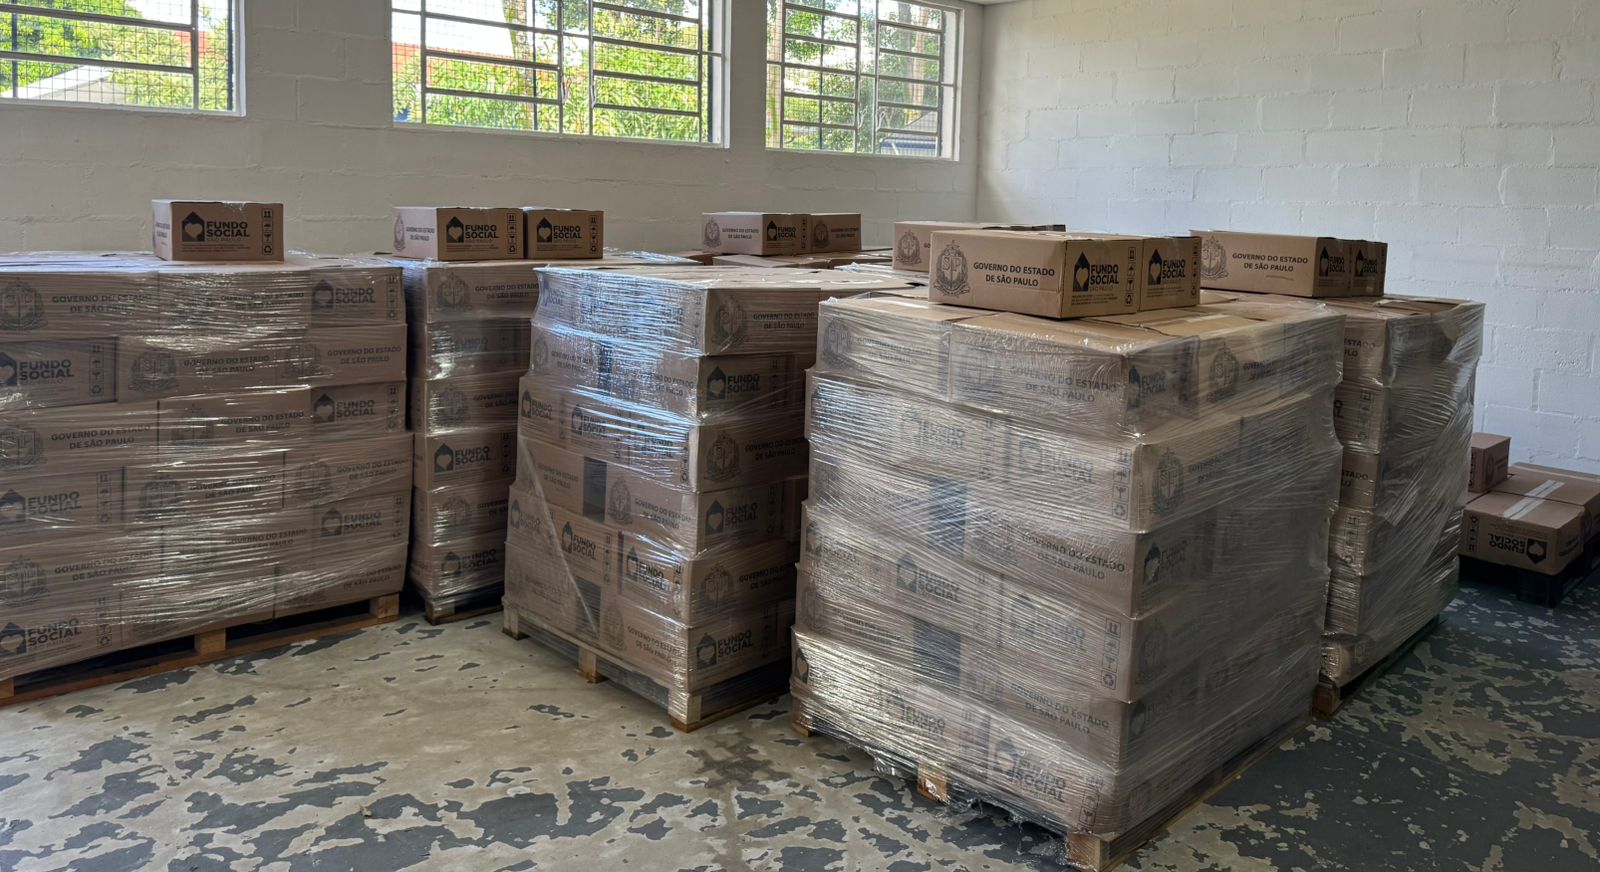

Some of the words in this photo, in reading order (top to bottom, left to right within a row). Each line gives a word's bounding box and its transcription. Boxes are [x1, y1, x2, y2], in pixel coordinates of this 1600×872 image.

[206, 221, 248, 229] FUNDO
[465, 224, 497, 232] FUNDO
[206, 230, 250, 238] SOCIAL
[465, 232, 499, 240] SOCIAL
[1163, 259, 1186, 268] FUNDO
[1232, 252, 1266, 261] GOVERNO
[1268, 254, 1278, 262] DO
[1280, 255, 1308, 264] ESTADO
[1329, 256, 1344, 265] FUNDO
[1363, 258, 1378, 266] FUNDO
[973, 262, 1008, 272] GOVERNO
[1010, 264, 1020, 274] DO
[1022, 266, 1055, 276] ESTADO
[1090, 264, 1119, 274] FUNDO
[1244, 262, 1253, 270] DE
[1254, 262, 1269, 270] SÃO
[1270, 264, 1294, 272] PAULO
[1329, 264, 1345, 273] SOCIAL
[1363, 264, 1378, 274] SOCIAL
[1162, 268, 1186, 279] SOCIAL
[985, 274, 995, 283] DE
[996, 274, 1011, 284] SÃO
[1013, 276, 1038, 287] PAULO
[1090, 275, 1120, 285] SOCIAL
[52, 294, 98, 302] GOVERNO
[335, 288, 374, 297] FUNDO
[335, 296, 376, 304] SOCIAL
[753, 312, 782, 320] GOVERNO
[794, 311, 814, 319] ESTADO
[328, 347, 360, 356] GOVERNO
[363, 347, 372, 355] DO
[375, 346, 401, 355] ESTADO
[341, 356, 350, 364] DE
[368, 354, 390, 364] PAULO
[20, 360, 72, 371] FUNDO
[20, 368, 74, 380] SOCIAL
[727, 374, 760, 384] FUNDO
[1011, 366, 1054, 381] GOVERNO
[1058, 376, 1072, 386] DO
[1076, 379, 1116, 393] ESTADO
[727, 382, 760, 393] SOCIAL
[1026, 384, 1036, 392] DE
[1040, 385, 1059, 397] SÃO
[1062, 390, 1095, 402] PAULO
[336, 400, 376, 409] FUNDO
[532, 400, 552, 412] FUNDO
[221, 415, 259, 425] GOVERNO
[262, 414, 272, 422] DO
[275, 412, 304, 420] ESTADO
[336, 408, 376, 418] SOCIAL
[532, 408, 552, 420] SOCIAL
[51, 430, 98, 441] GOVERNO
[101, 428, 113, 436] DO
[70, 441, 83, 450] DE
[86, 440, 105, 448] SÃO
[108, 437, 134, 446] PAULO
[745, 441, 772, 452] GOVERNO
[455, 446, 490, 458] FUNDO
[455, 454, 492, 466] SOCIAL
[28, 492, 80, 505] FUNDO
[30, 500, 82, 514] SOCIAL
[634, 498, 658, 512] GOVERNO
[660, 505, 667, 515] DO
[726, 502, 758, 516] FUNDO
[344, 511, 382, 522] FUNDO
[726, 512, 759, 526] SOCIAL
[266, 531, 276, 540] DO
[279, 528, 308, 538] ESTADO
[1488, 533, 1526, 546] SOCIAL
[573, 535, 596, 550] FUNDO
[1488, 540, 1524, 554] FUNDO
[462, 549, 496, 562] FUNDO
[573, 544, 596, 560] SOCIAL
[462, 556, 498, 568] SOCIAL
[1038, 552, 1050, 564] DE
[1073, 564, 1106, 580] PAULO
[1084, 554, 1125, 572] ESTADO
[72, 572, 86, 581] DE
[739, 568, 768, 583] GOVERNO
[750, 582, 758, 590] DE
[918, 581, 961, 603] SOCIAL
[27, 618, 80, 636] FUNDO
[28, 627, 82, 648] SOCIAL
[718, 630, 752, 646] FUNDO
[718, 640, 754, 658] SOCIAL
[1025, 702, 1037, 714] DE
[1060, 716, 1090, 734] PAULO
[1055, 702, 1069, 714] DO
[1072, 710, 1110, 729] ESTADO
[1016, 770, 1065, 804] SOCIAL
